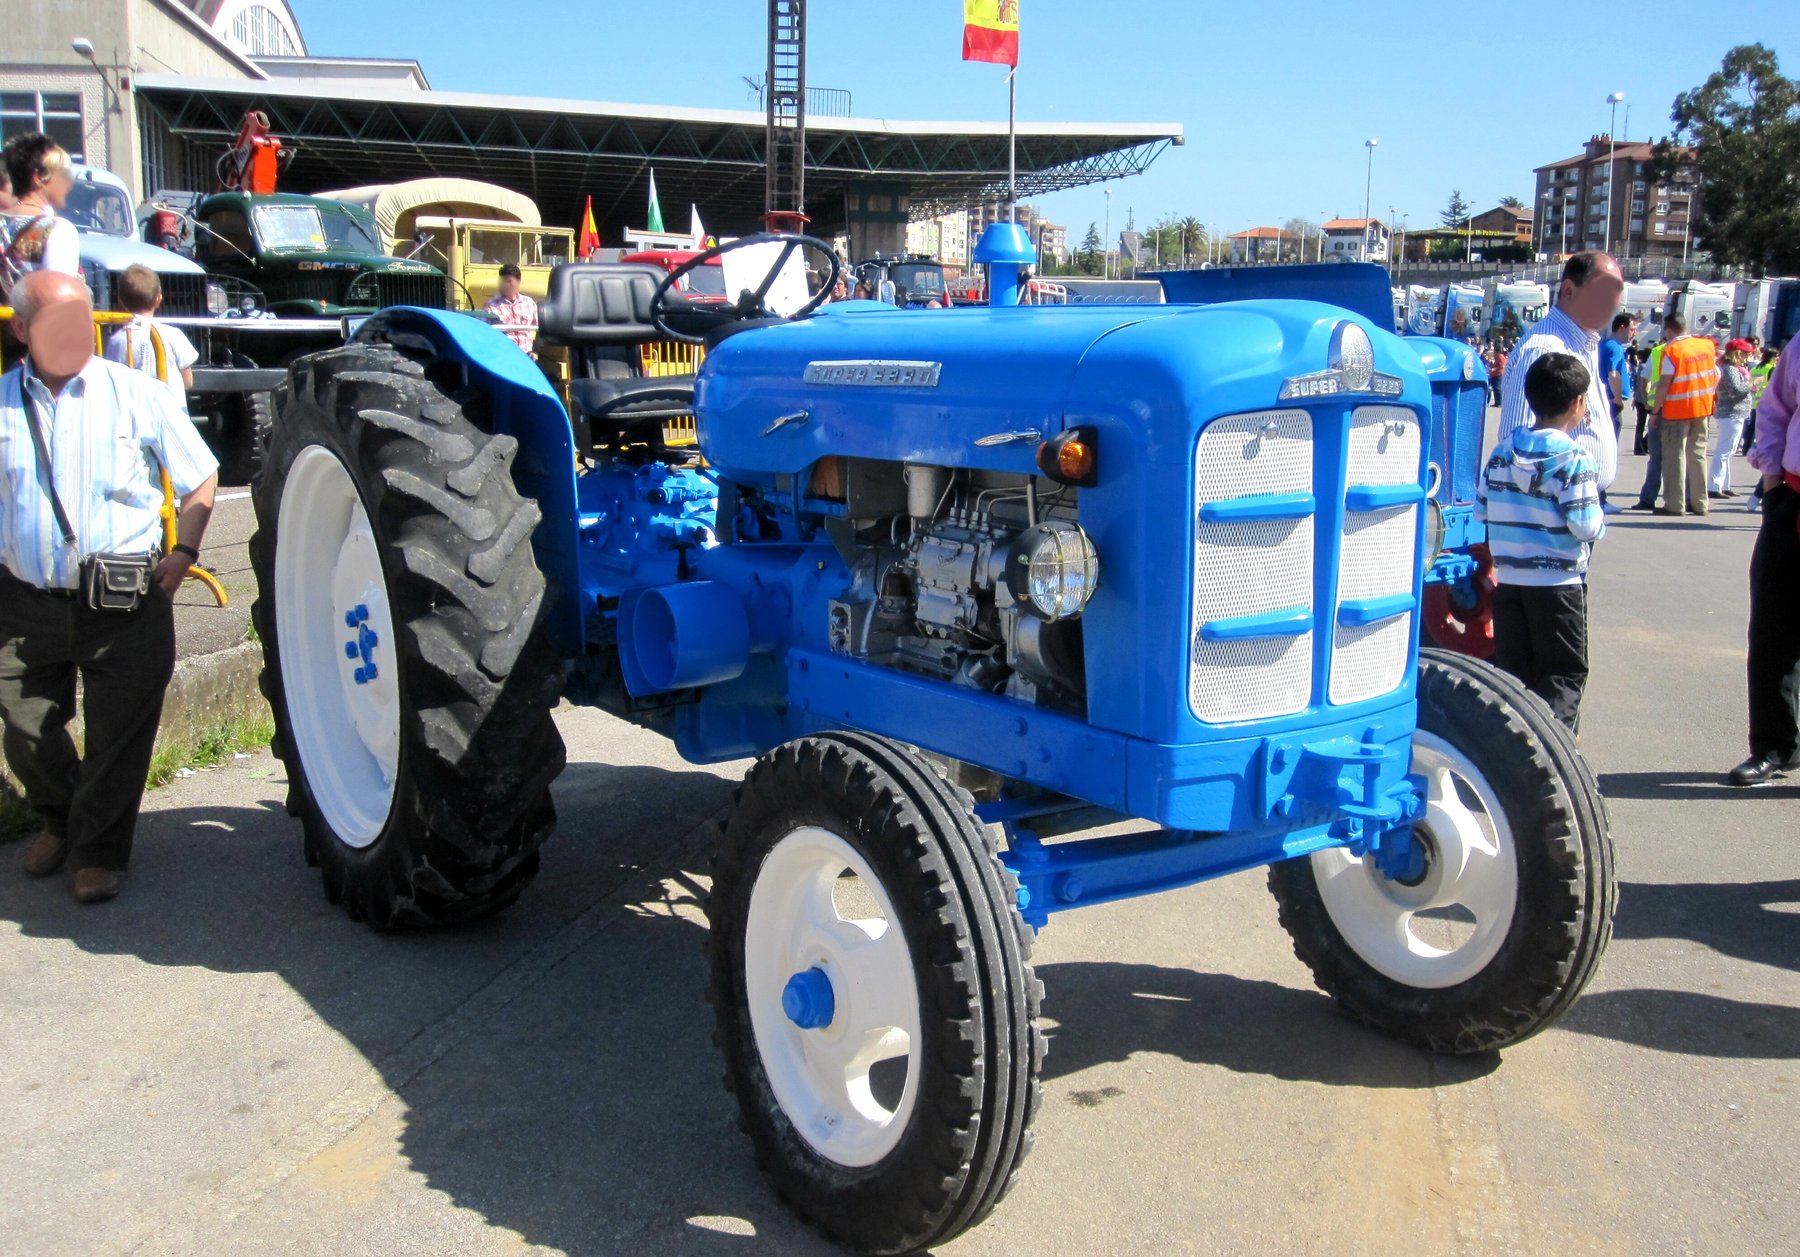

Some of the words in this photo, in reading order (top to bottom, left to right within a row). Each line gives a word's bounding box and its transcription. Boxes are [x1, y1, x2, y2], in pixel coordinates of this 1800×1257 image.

[387, 261, 431, 272] Forestal
[812, 367, 869, 383] SUPER
[873, 367, 933, 384] EBRO
[1290, 378, 1339, 398] SUPER
